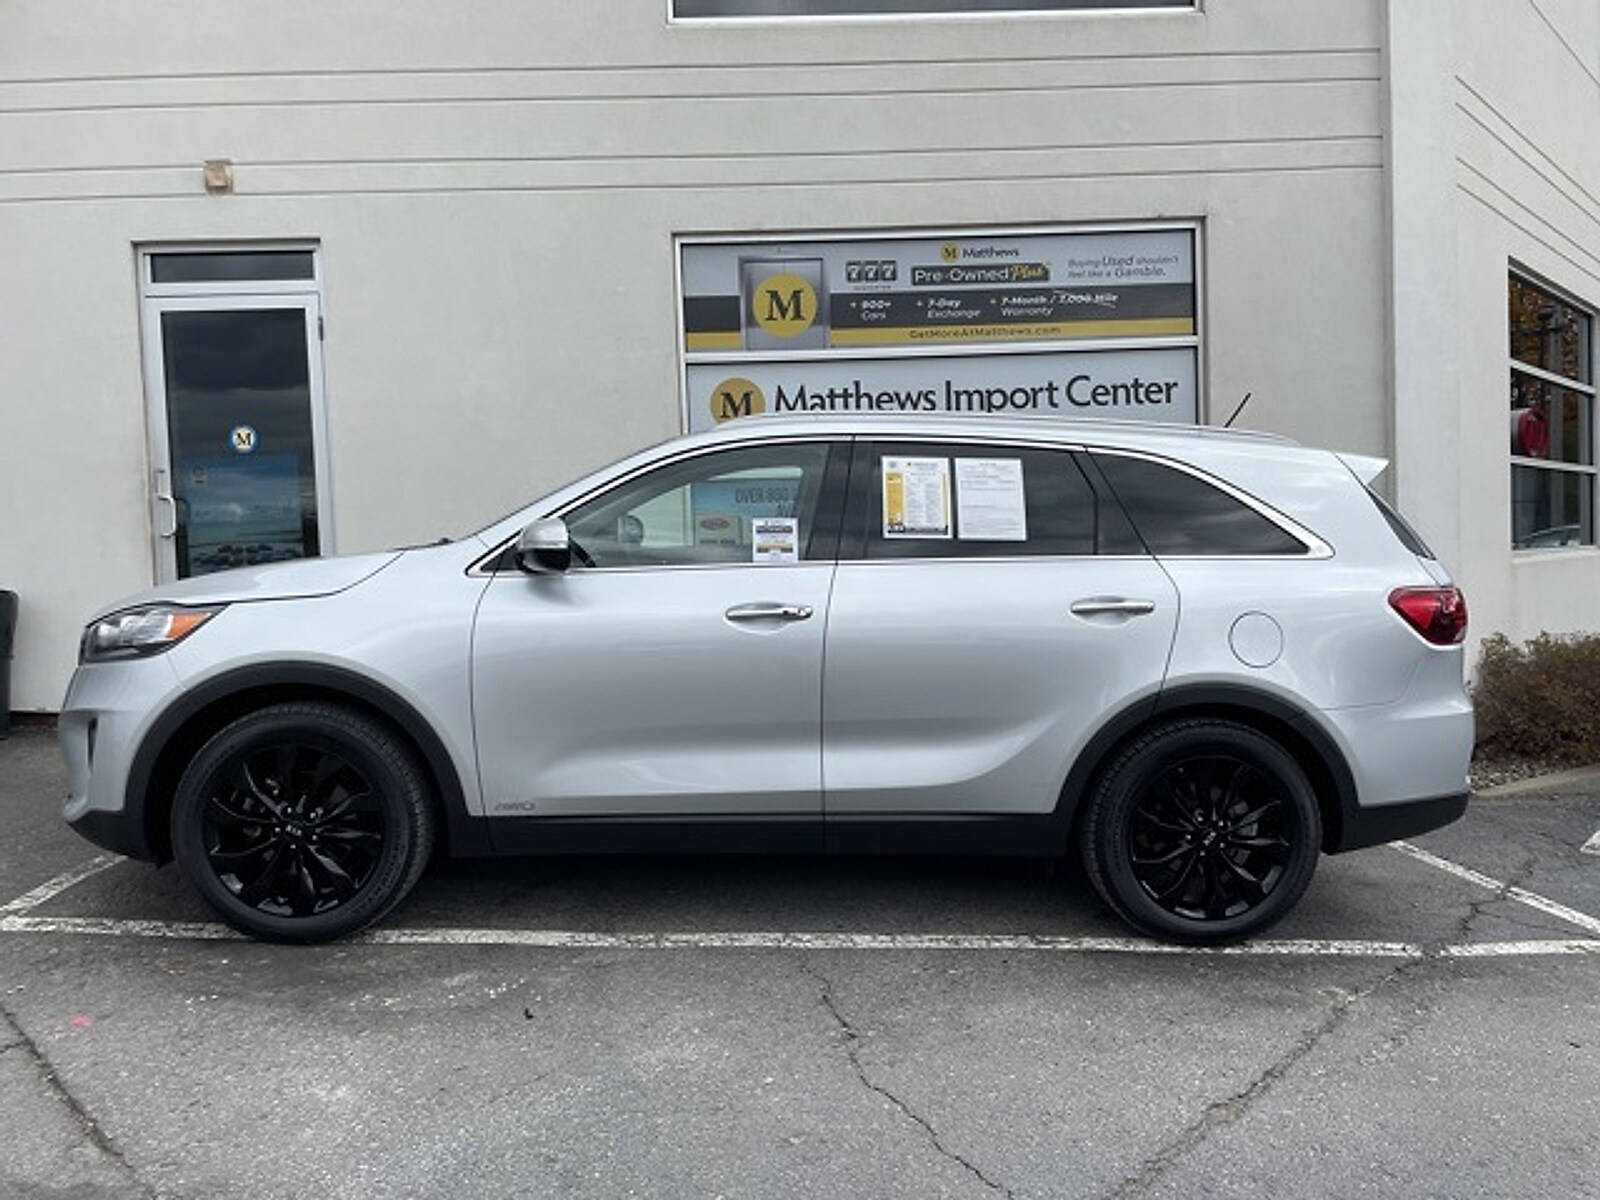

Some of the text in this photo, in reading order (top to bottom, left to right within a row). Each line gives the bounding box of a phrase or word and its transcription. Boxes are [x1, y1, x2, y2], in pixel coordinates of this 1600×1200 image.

[962, 246, 1019, 259] Matthews
[1102, 256, 1134, 266] Used
[765, 290, 806, 321] M
[927, 309, 981, 319] Exchange
[720, 375, 1179, 418] M Matthews Import Center
